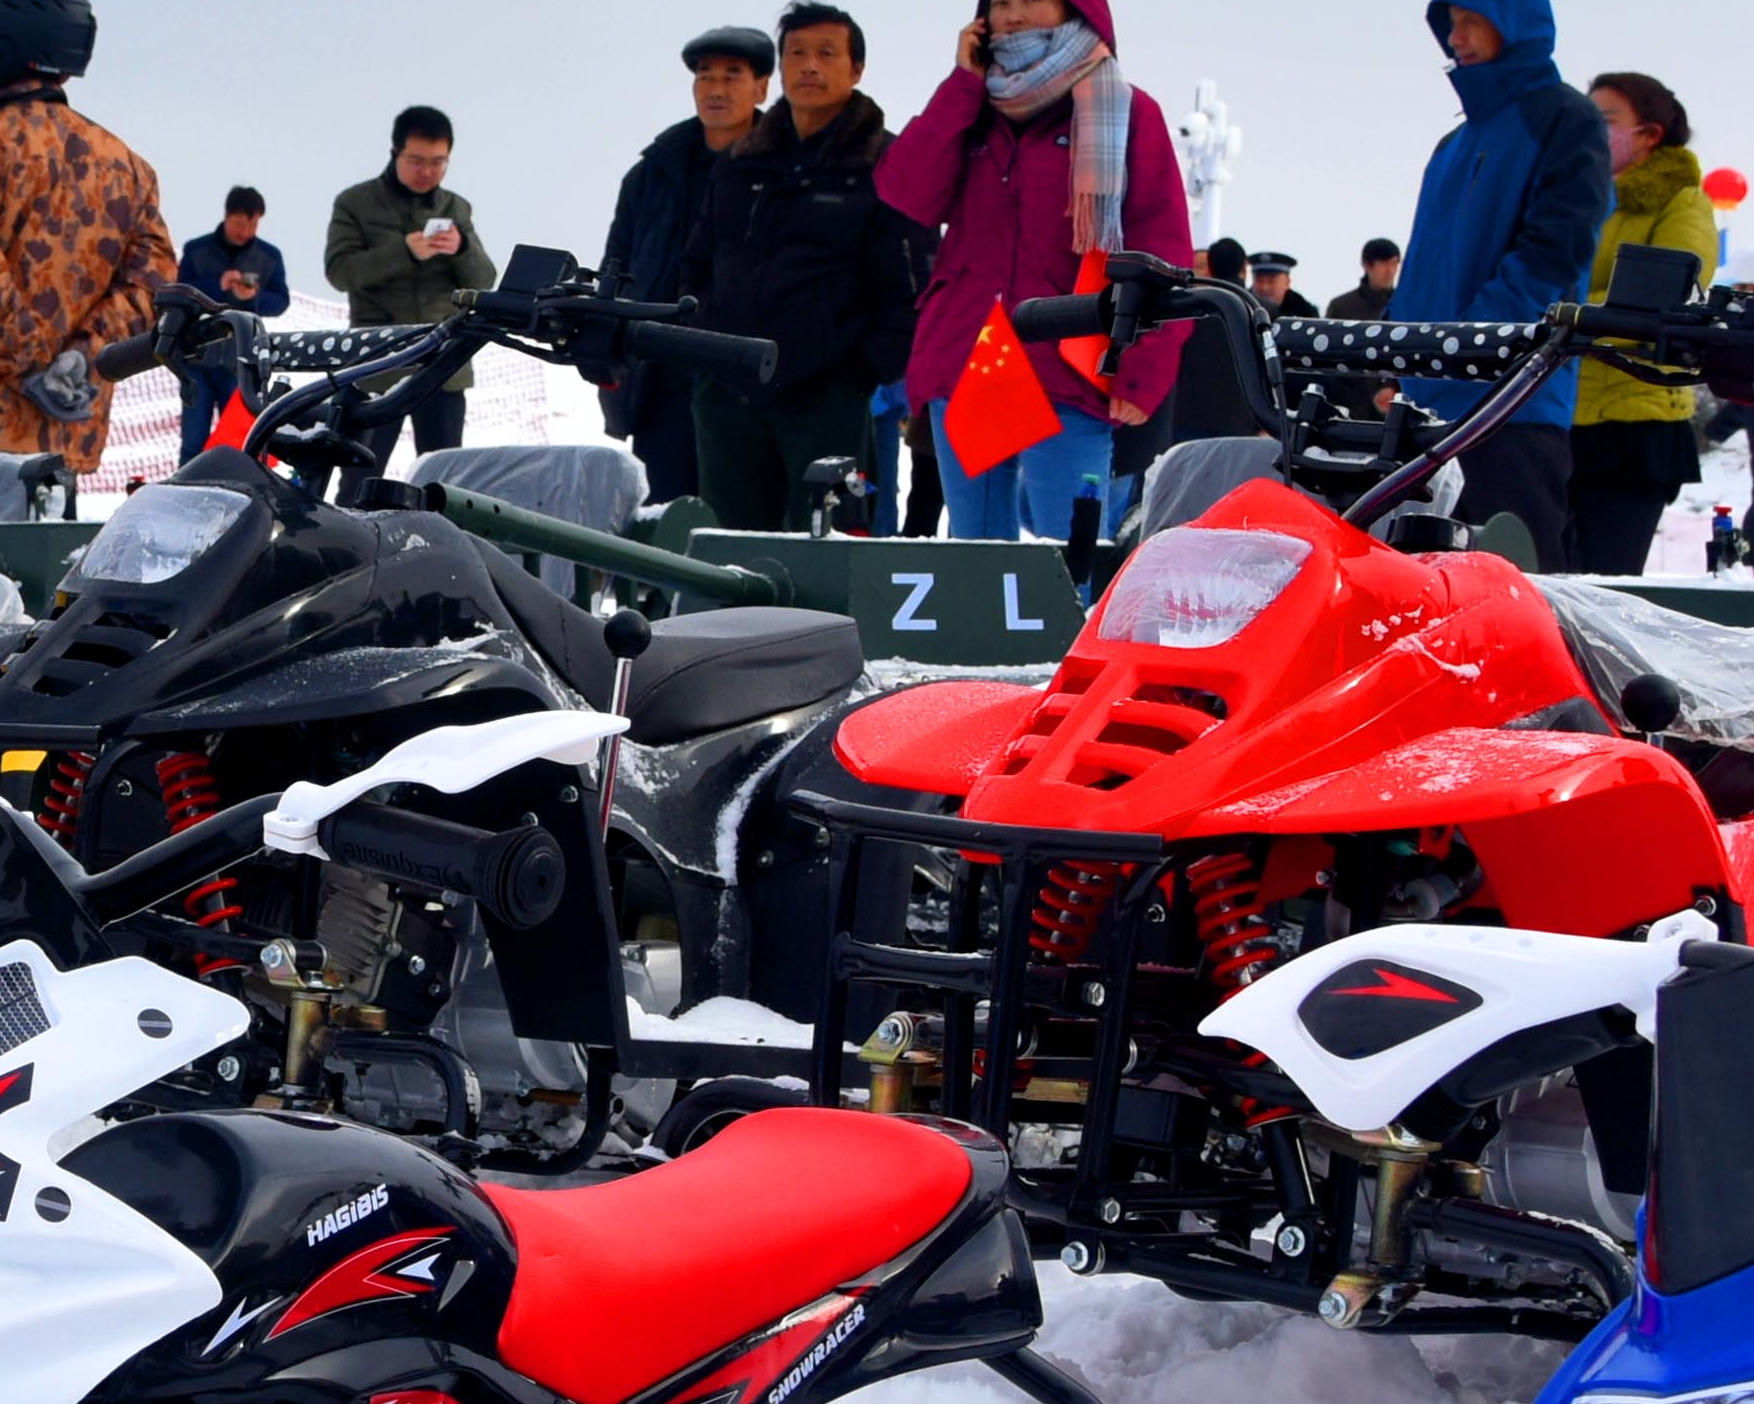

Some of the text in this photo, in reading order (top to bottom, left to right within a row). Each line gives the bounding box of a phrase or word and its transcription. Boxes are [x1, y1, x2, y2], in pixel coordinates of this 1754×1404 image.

[891, 573, 1044, 630] Z L
[307, 1182, 390, 1248] HAGIBIS
